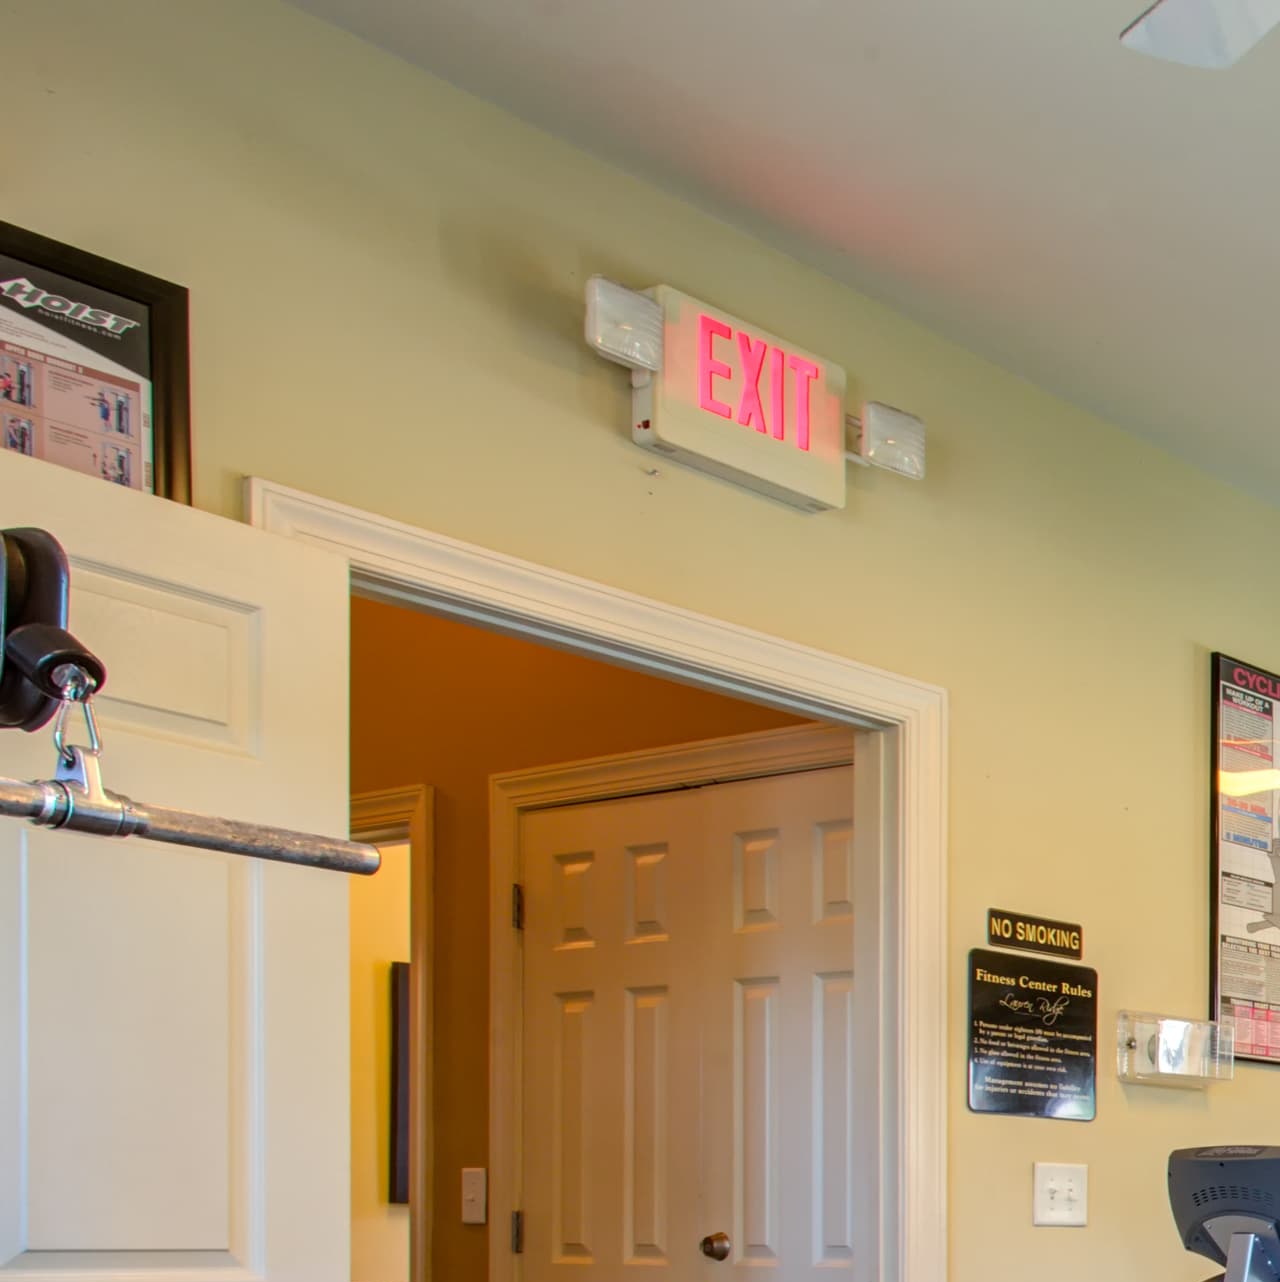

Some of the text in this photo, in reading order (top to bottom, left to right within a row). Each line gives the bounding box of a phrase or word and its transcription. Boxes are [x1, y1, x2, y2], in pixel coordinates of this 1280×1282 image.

[2, 279, 139, 334] HOIST
[699, 314, 819, 452] EXIT
[991, 917, 1080, 950] NO SMOKING
[976, 968, 1092, 998] Fitness Center Rules
